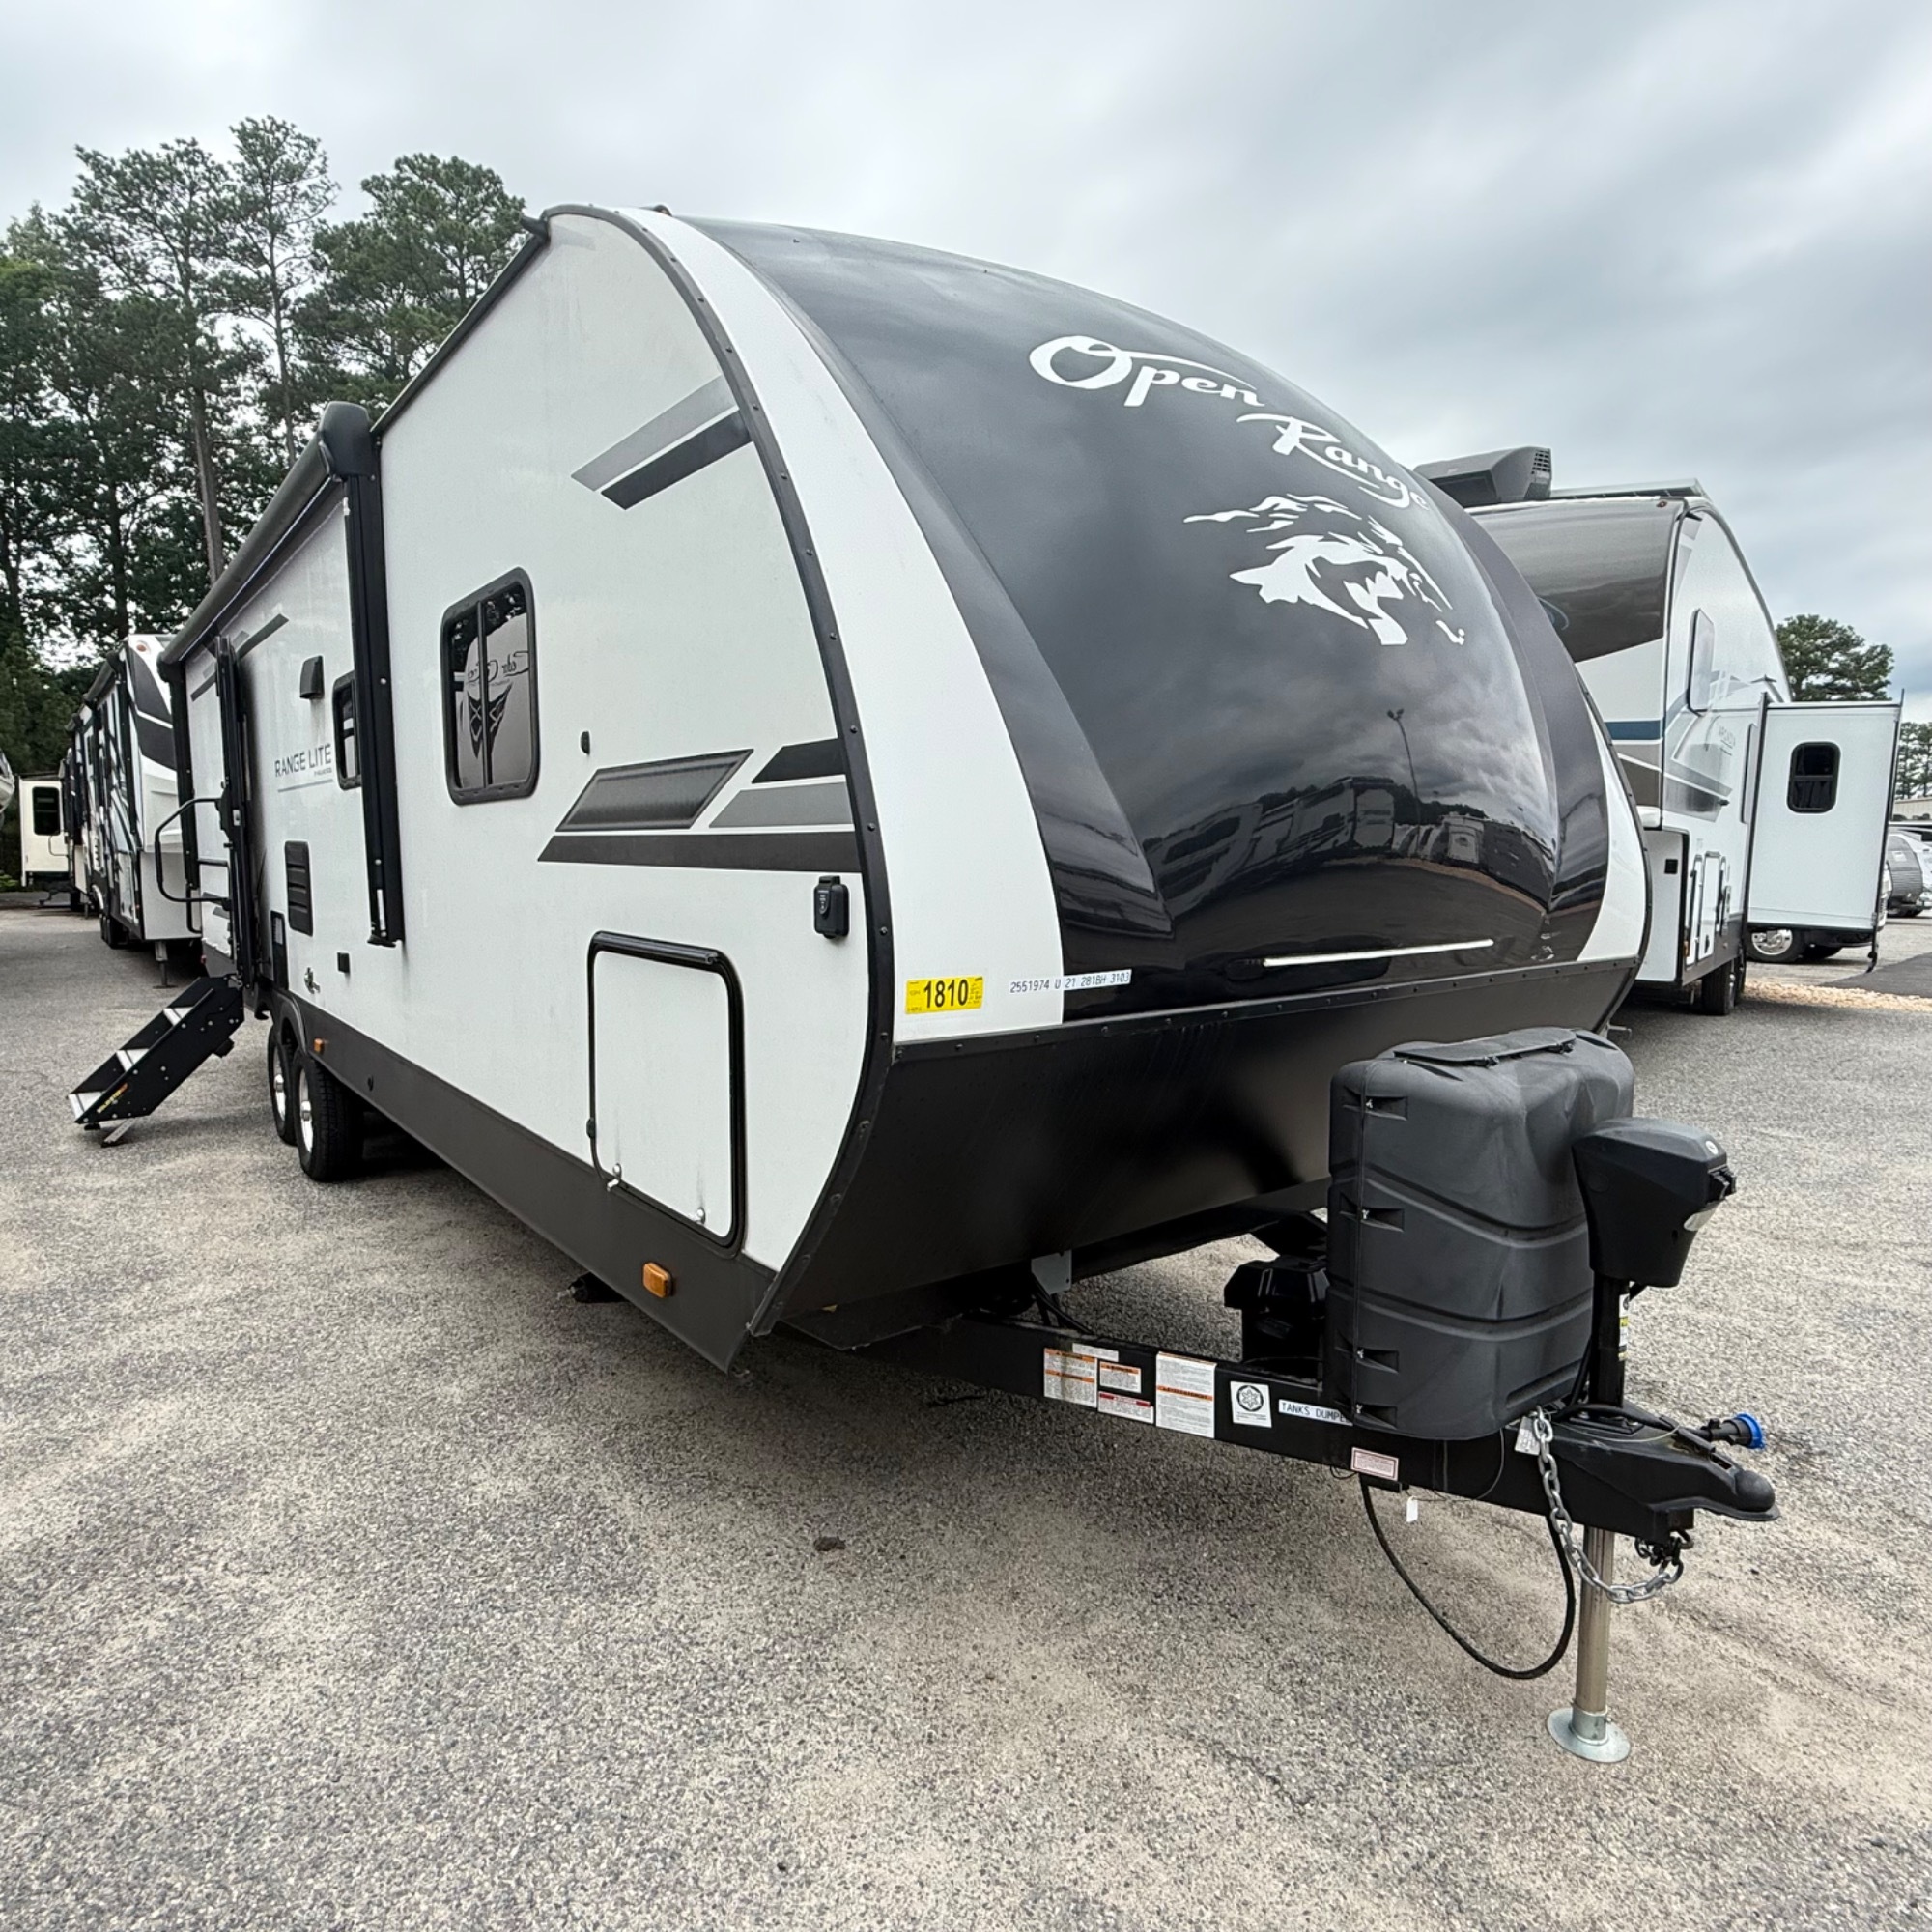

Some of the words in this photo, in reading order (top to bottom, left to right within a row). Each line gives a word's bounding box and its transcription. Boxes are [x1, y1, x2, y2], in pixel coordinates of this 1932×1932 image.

[1029, 336, 1265, 408] Open
[1236, 413, 1430, 511] Range
[275, 752, 305, 777] RANGE
[308, 744, 331, 768] LITE
[923, 979, 969, 1009] 1810
[1009, 979, 1050, 993] 2551974
[1065, 977, 1076, 989] 21
[1281, 1401, 1311, 1416] TANKS
[1315, 1407, 1350, 1423] DUMPE
